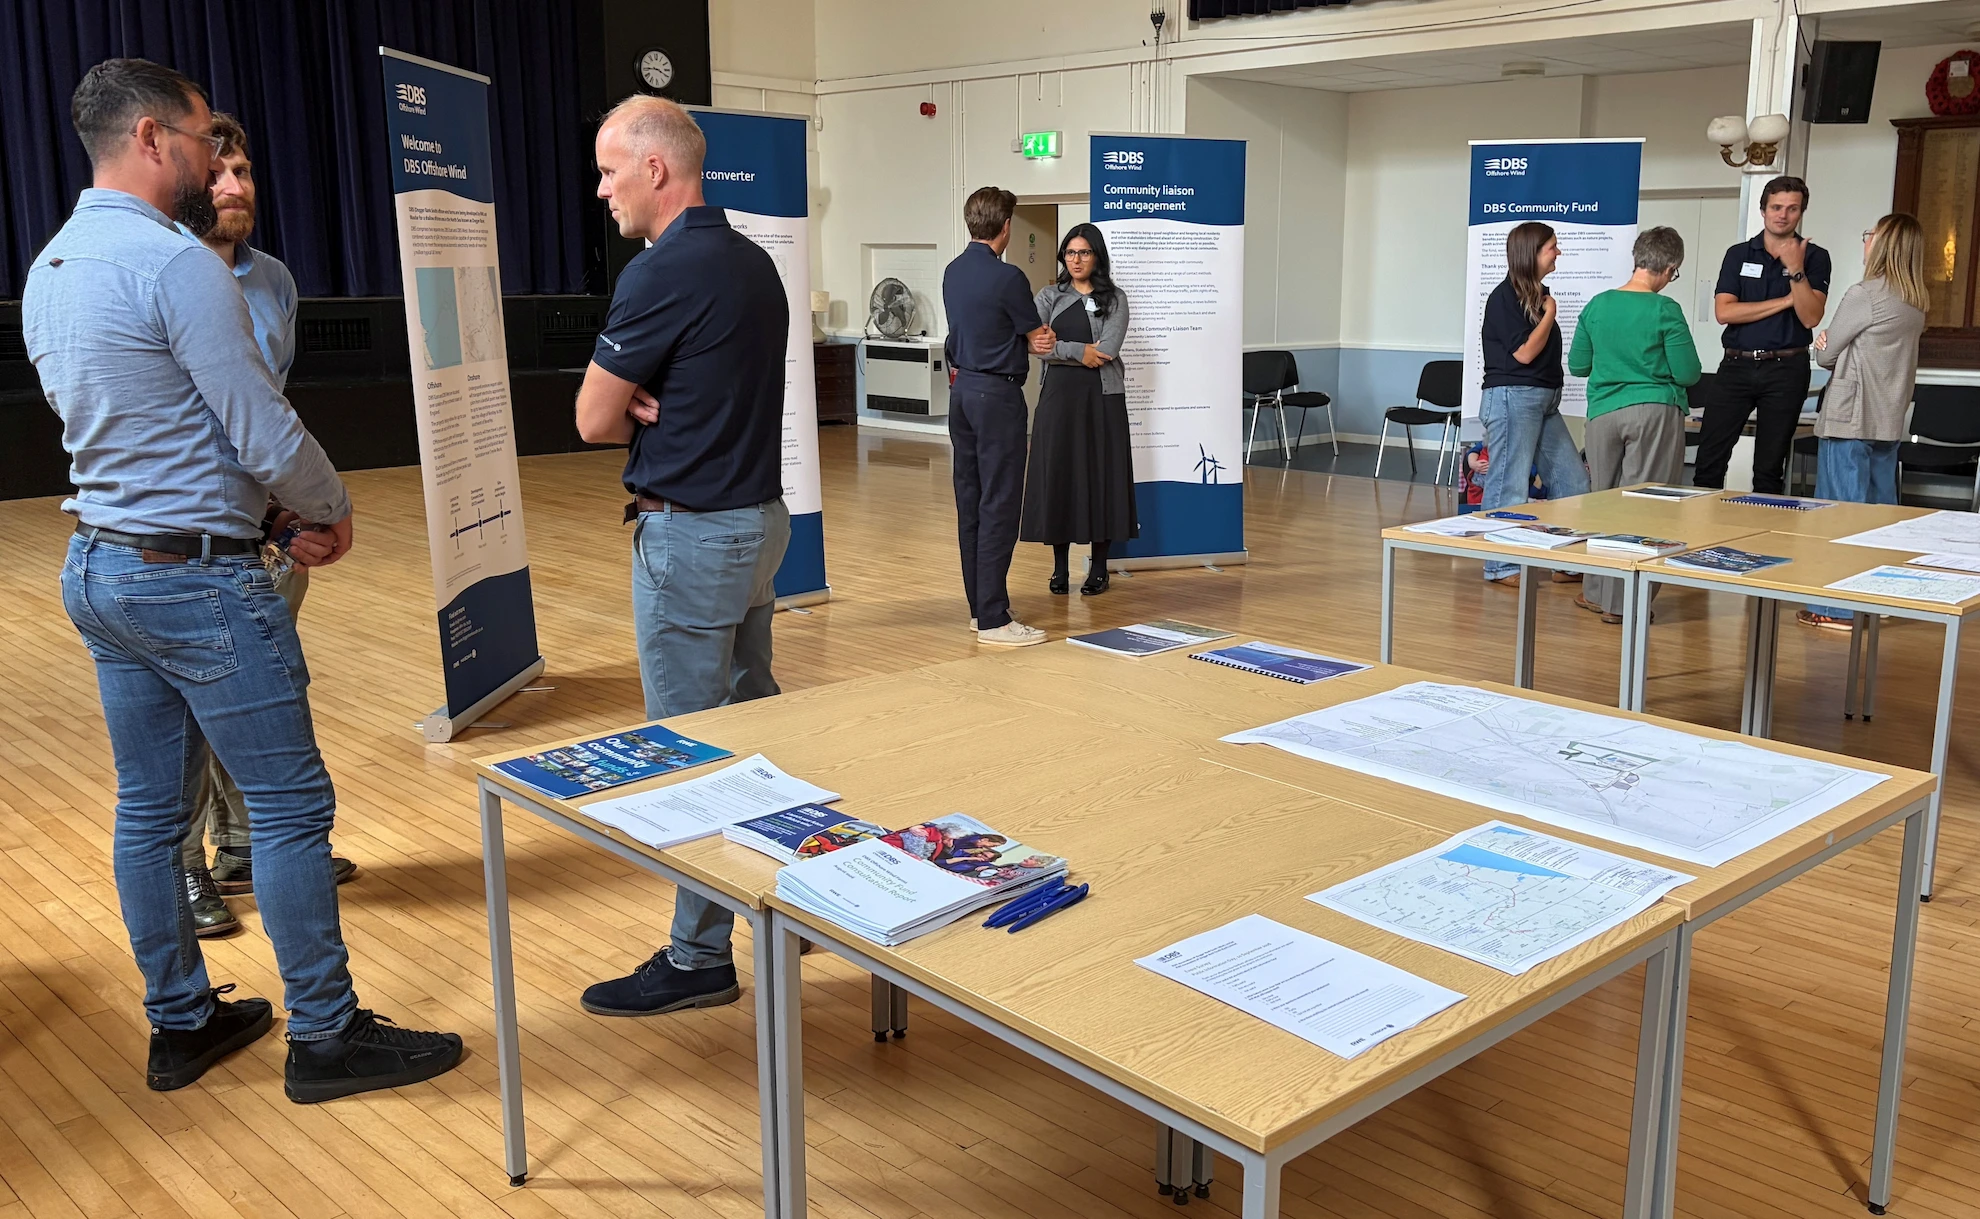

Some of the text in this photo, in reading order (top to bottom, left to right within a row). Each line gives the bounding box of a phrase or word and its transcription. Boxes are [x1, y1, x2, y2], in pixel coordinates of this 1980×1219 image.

[407, 84, 426, 106] DBS
[399, 102, 426, 116] Offshore Wind
[401, 134, 442, 154] Welcome to
[1119, 152, 1144, 164] DBS
[1501, 158, 1528, 170] DBS
[404, 158, 467, 180] DBS Offshore Wind
[706, 170, 755, 182] converter
[1104, 184, 1194, 197] Community liaison
[1104, 200, 1186, 212] and engagement
[1484, 202, 1598, 214] DBS Community Fund
[605, 738, 630, 749] Our
[588, 743, 650, 768] community
[594, 760, 629, 773] funds
[884, 854, 901, 864] DBS
[843, 861, 916, 903] Consultation Report
[853, 858, 917, 895] Community Fund
